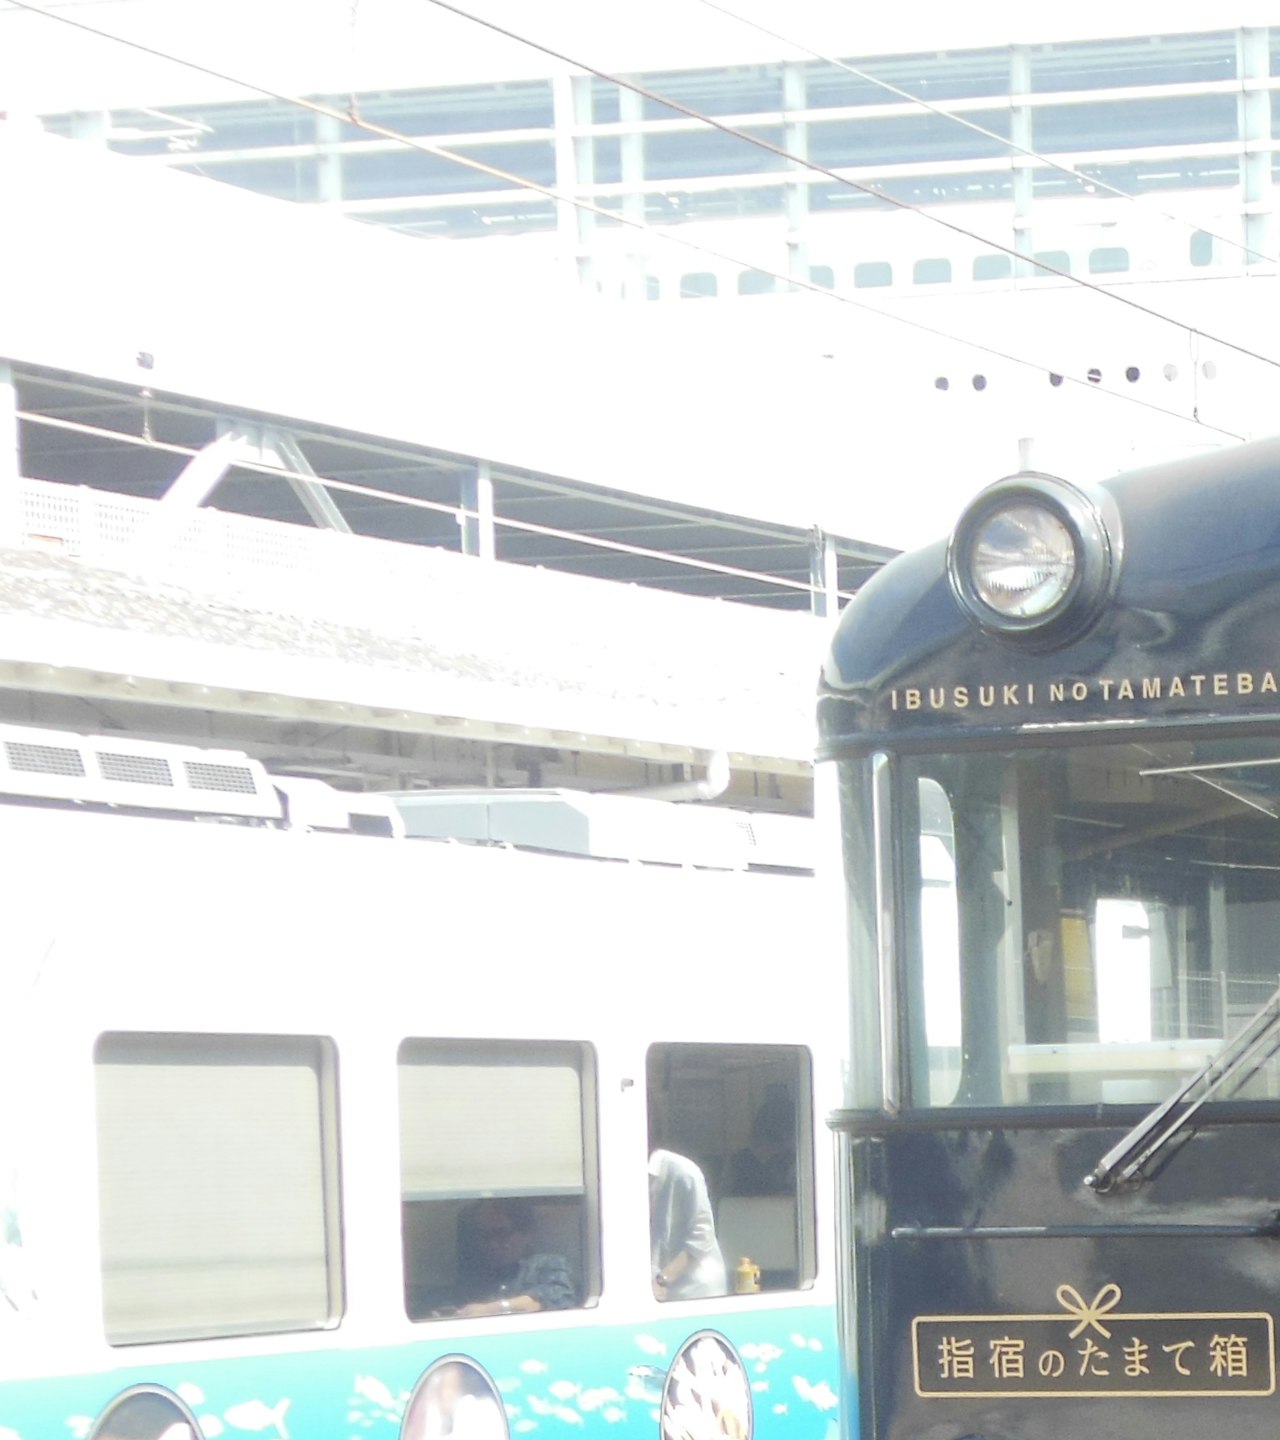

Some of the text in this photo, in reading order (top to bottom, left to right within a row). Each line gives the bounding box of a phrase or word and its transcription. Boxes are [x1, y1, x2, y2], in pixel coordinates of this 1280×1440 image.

[891, 684, 1035, 711] IBUSUKI
[1050, 683, 1087, 702] NO
[938, 1334, 1247, 1378] 指宿のたまて箱
